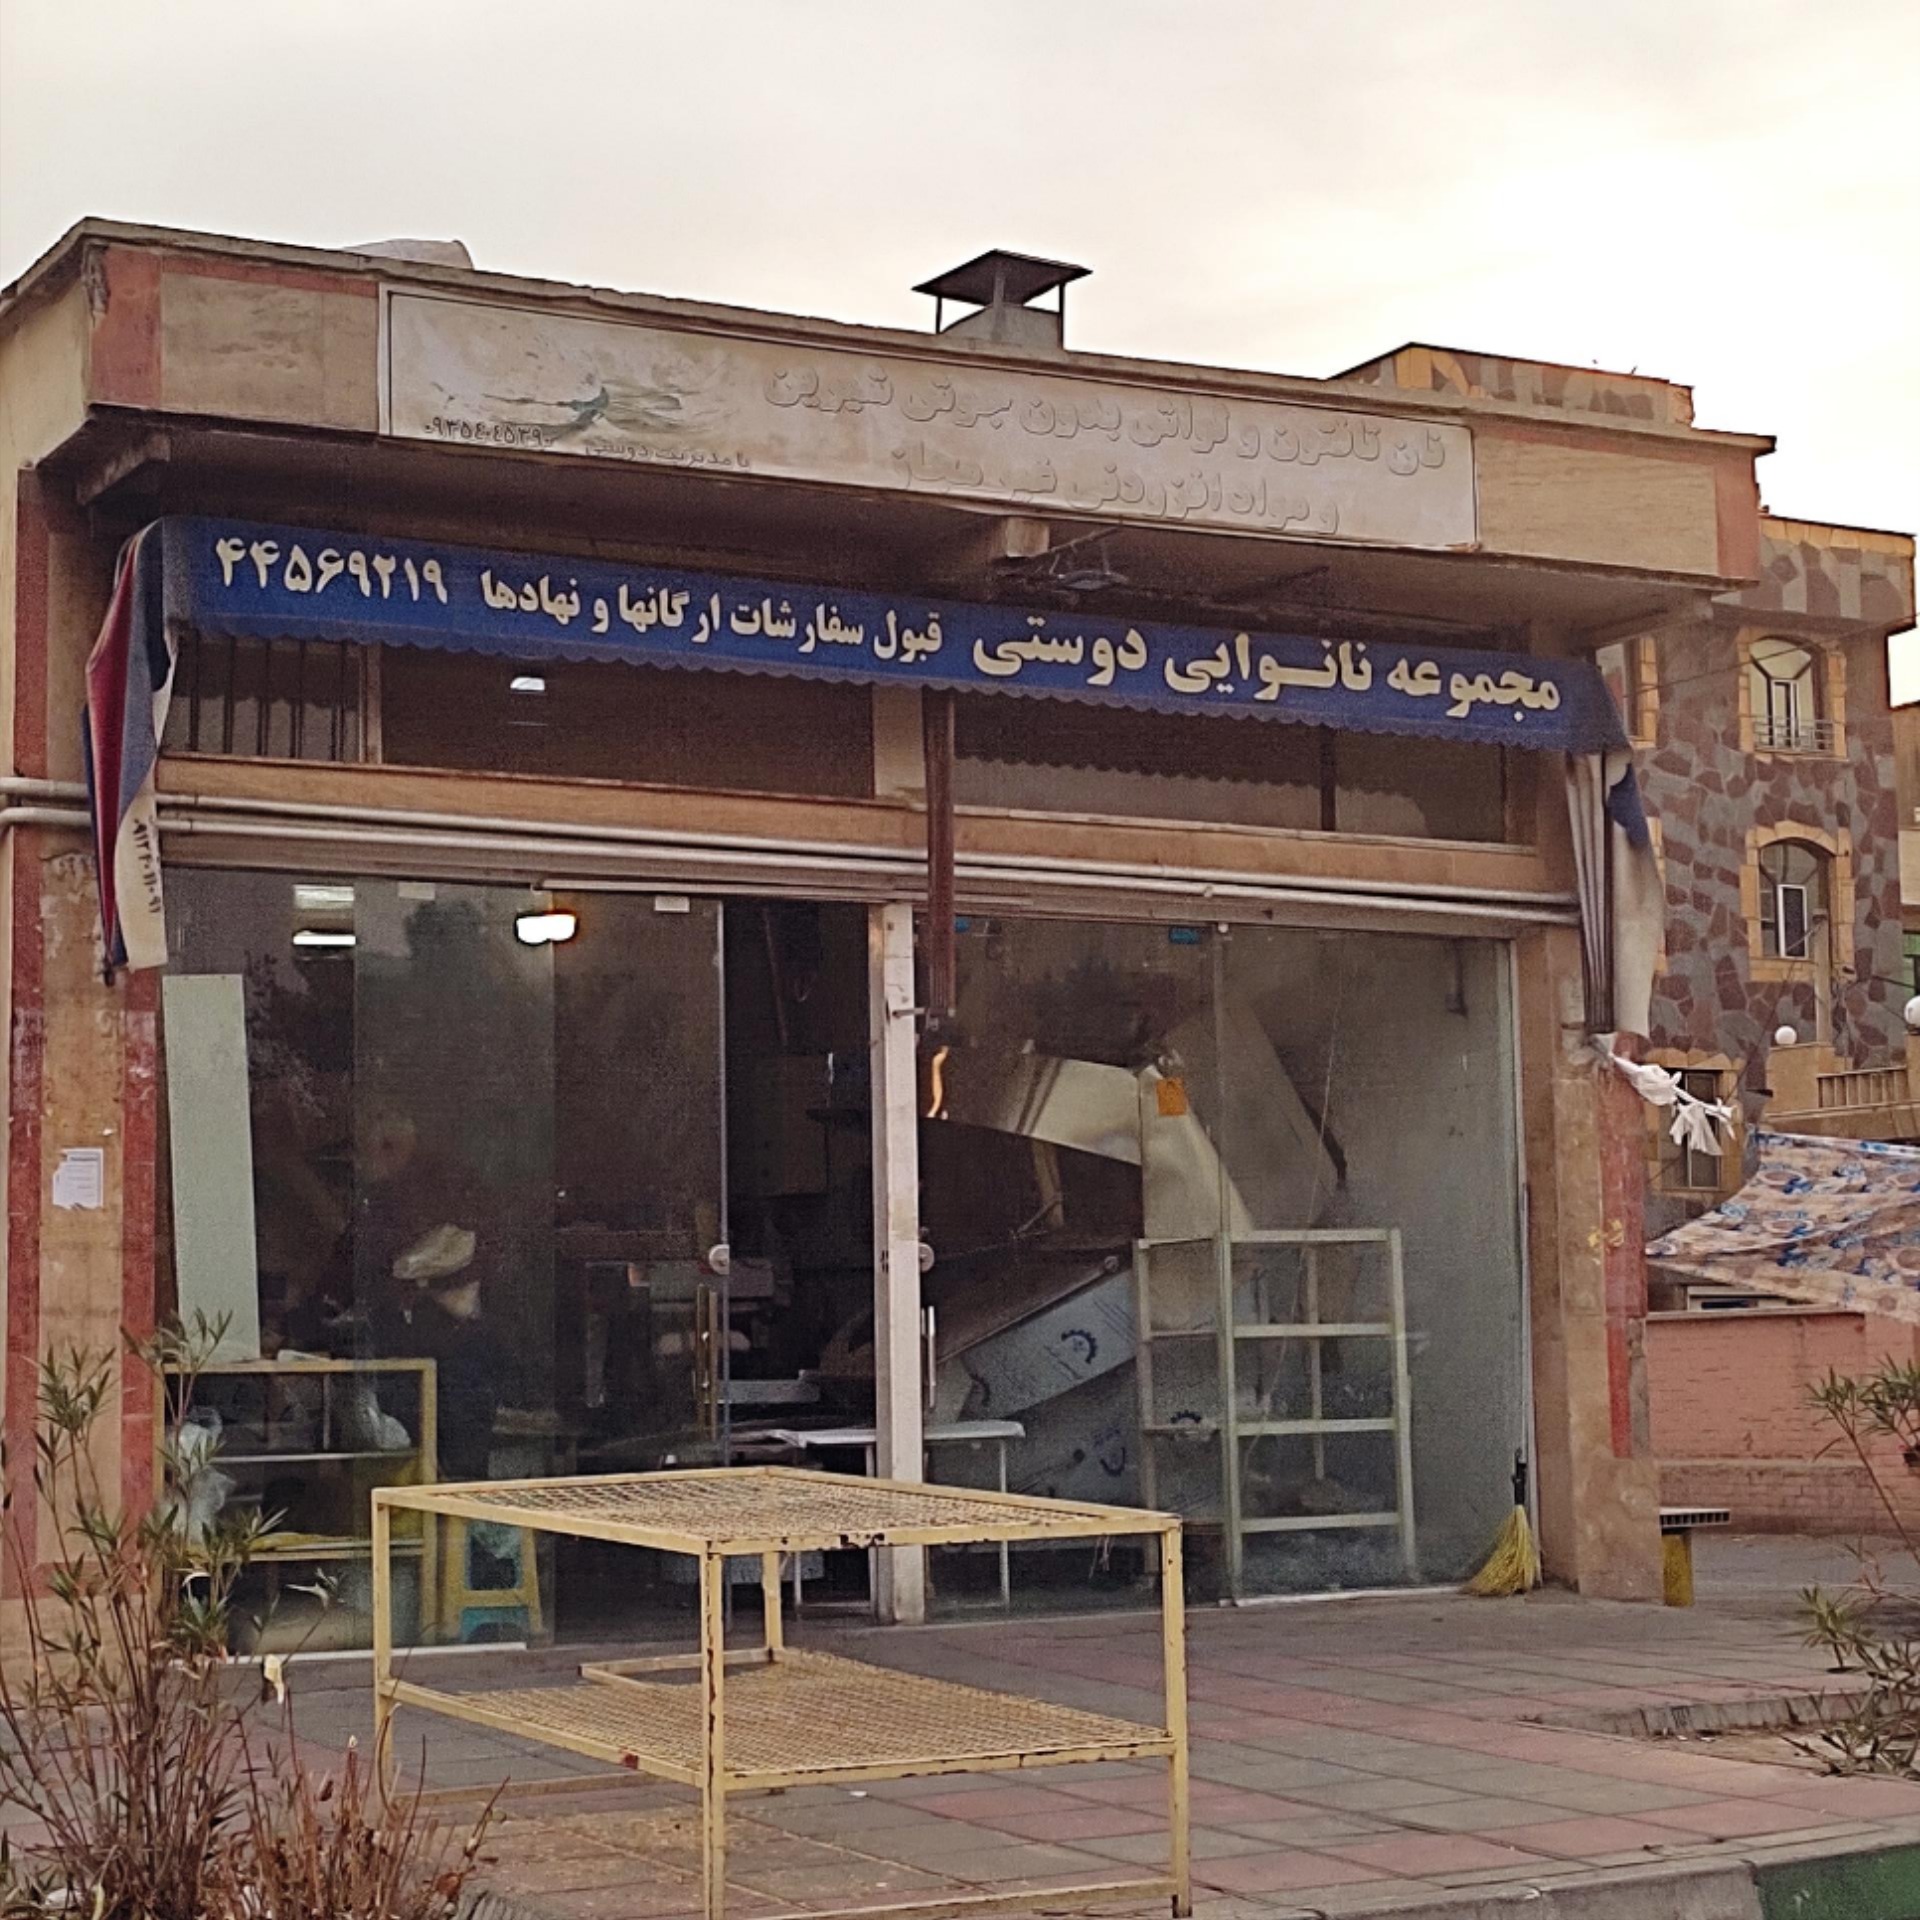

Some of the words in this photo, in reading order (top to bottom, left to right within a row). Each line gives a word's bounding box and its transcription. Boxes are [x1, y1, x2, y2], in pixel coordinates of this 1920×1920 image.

[1018, 396, 1122, 442] بدون
[1236, 424, 1260, 460] و
[1386, 427, 1445, 476] نان
[216, 538, 448, 604] ۴۴۵۶۹۲۱۹
[481, 570, 581, 625] نهادها
[591, 598, 609, 633] و
[618, 584, 720, 643] ارگانها
[730, 603, 864, 653] سفارشات
[873, 610, 942, 663] قبول
[973, 616, 1147, 686] دوستی
[1164, 633, 1372, 701] نانوایی
[1387, 658, 1560, 722] مجموعه
